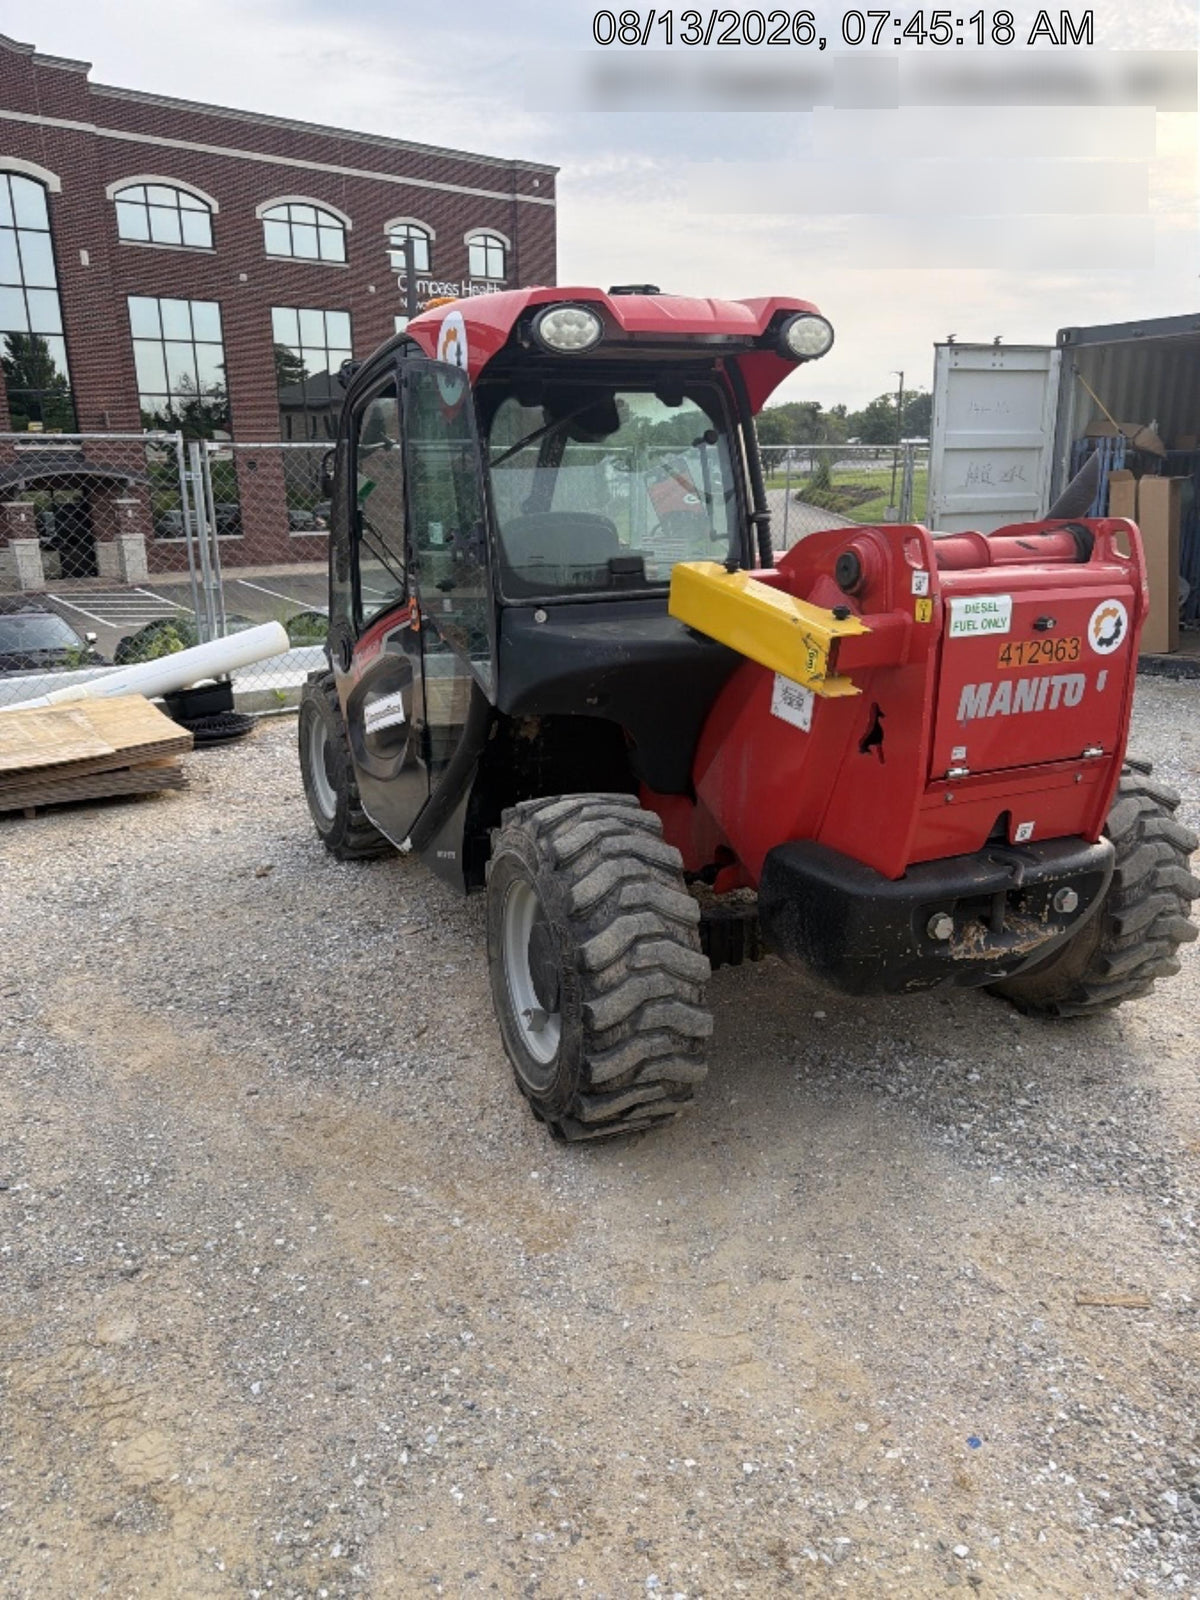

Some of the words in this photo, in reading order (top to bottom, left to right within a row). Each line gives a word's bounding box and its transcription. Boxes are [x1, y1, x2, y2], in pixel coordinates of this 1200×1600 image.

[397, 274, 460, 297] Cmpass
[964, 601, 1000, 614] DIESEL
[953, 618, 979, 632] FUEL
[981, 616, 1007, 631] ONLY
[1000, 637, 1080, 667] 412963
